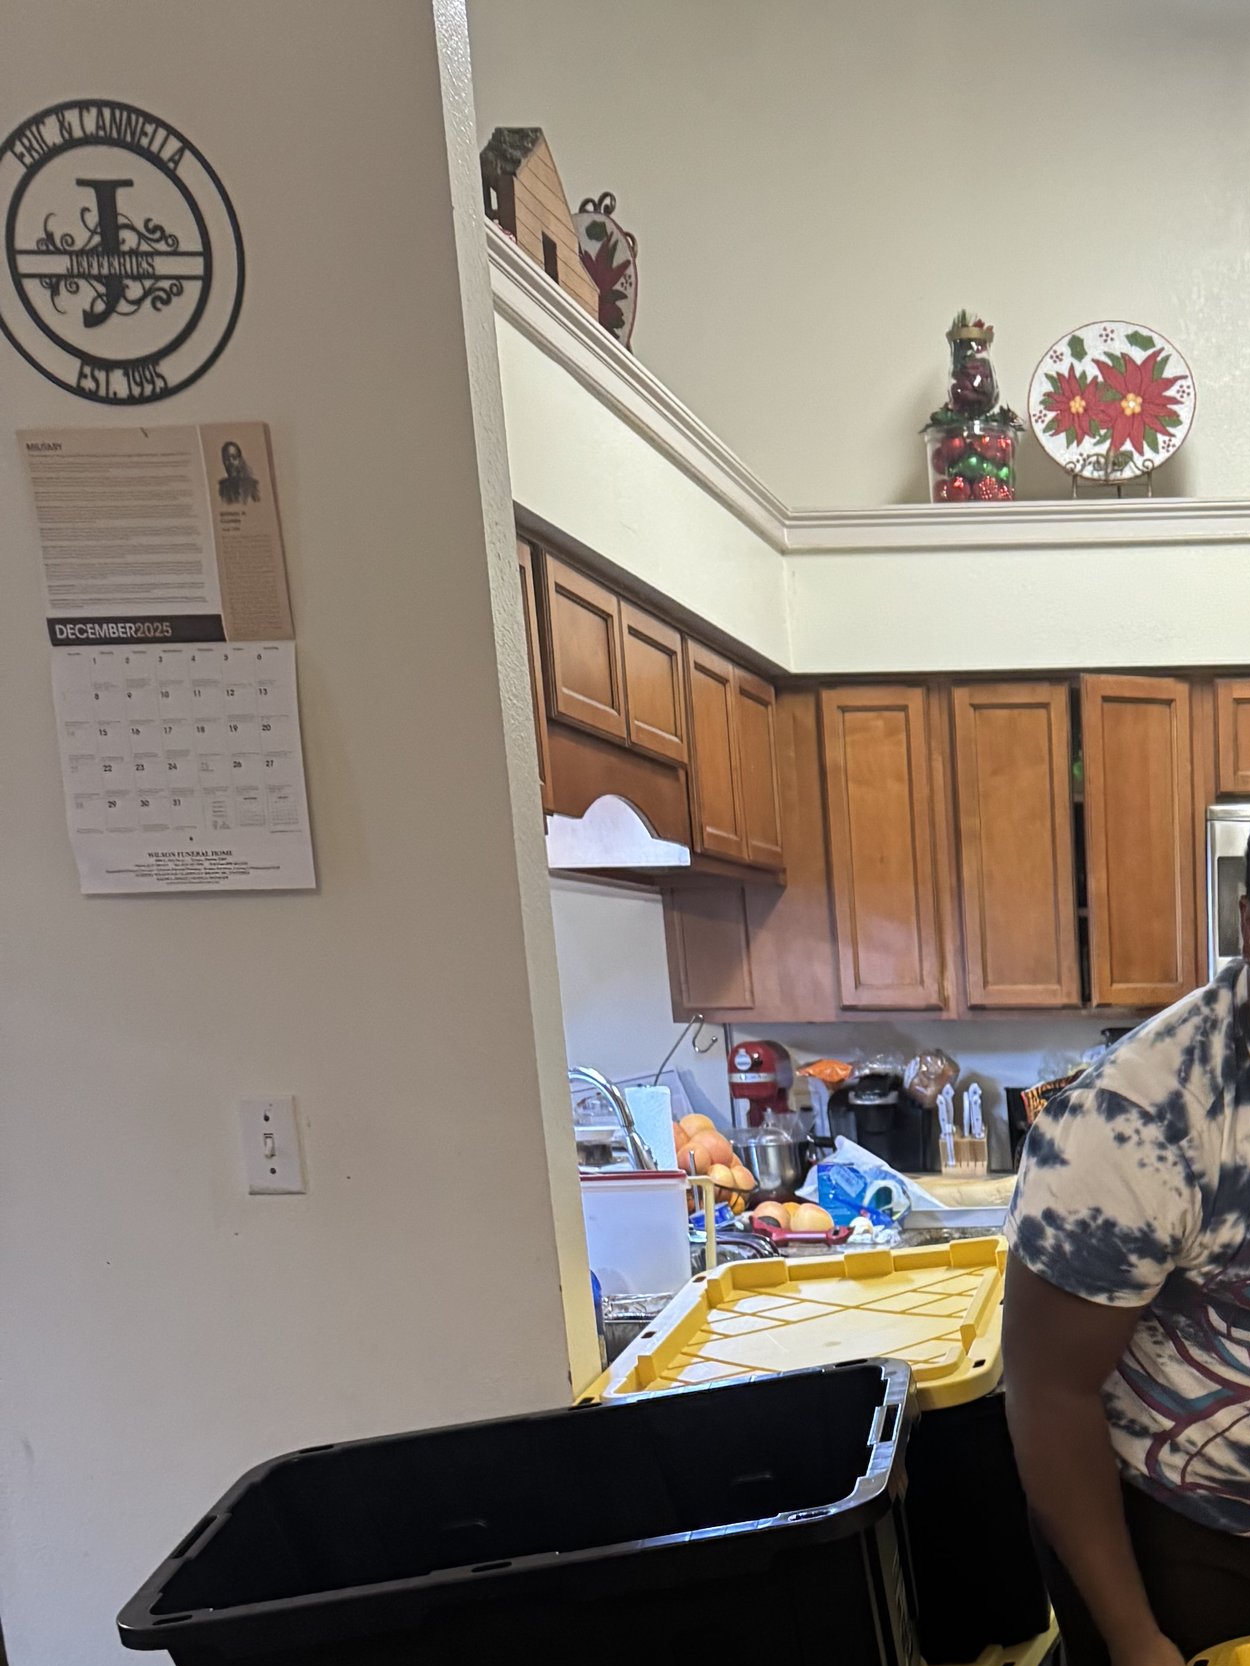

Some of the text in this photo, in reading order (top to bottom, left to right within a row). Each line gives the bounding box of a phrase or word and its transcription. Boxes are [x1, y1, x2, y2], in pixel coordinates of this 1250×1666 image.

[56, 110, 73, 141] &
[79, 106, 188, 172] CANNELLA
[123, 361, 169, 399] 1995
